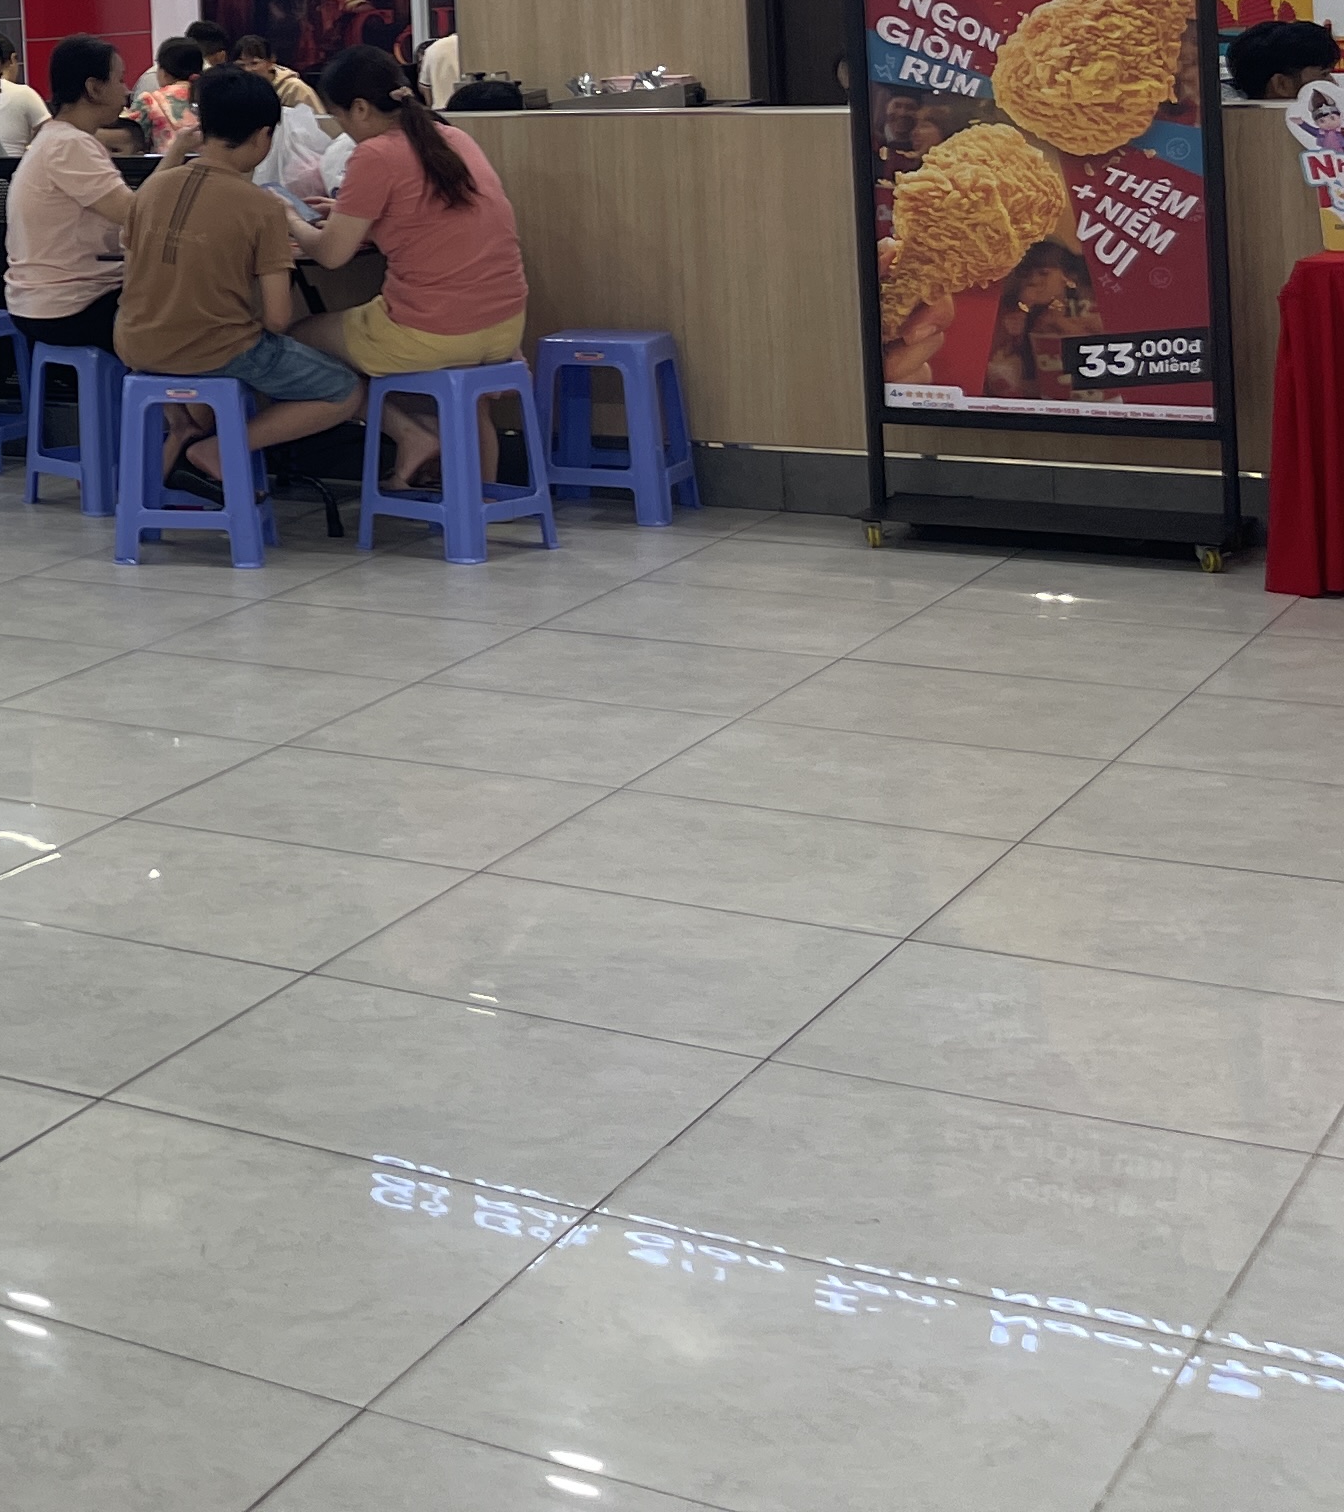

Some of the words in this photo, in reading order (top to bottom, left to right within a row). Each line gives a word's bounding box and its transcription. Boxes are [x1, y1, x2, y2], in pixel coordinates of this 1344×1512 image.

[876, 15, 974, 70] GIÒN
[898, 55, 981, 98] RỤM
[1104, 167, 1200, 220] THÊM
[1076, 210, 1139, 278] VUI
[1094, 195, 1177, 256] NIỀM
[1149, 357, 1202, 374] Miếng
